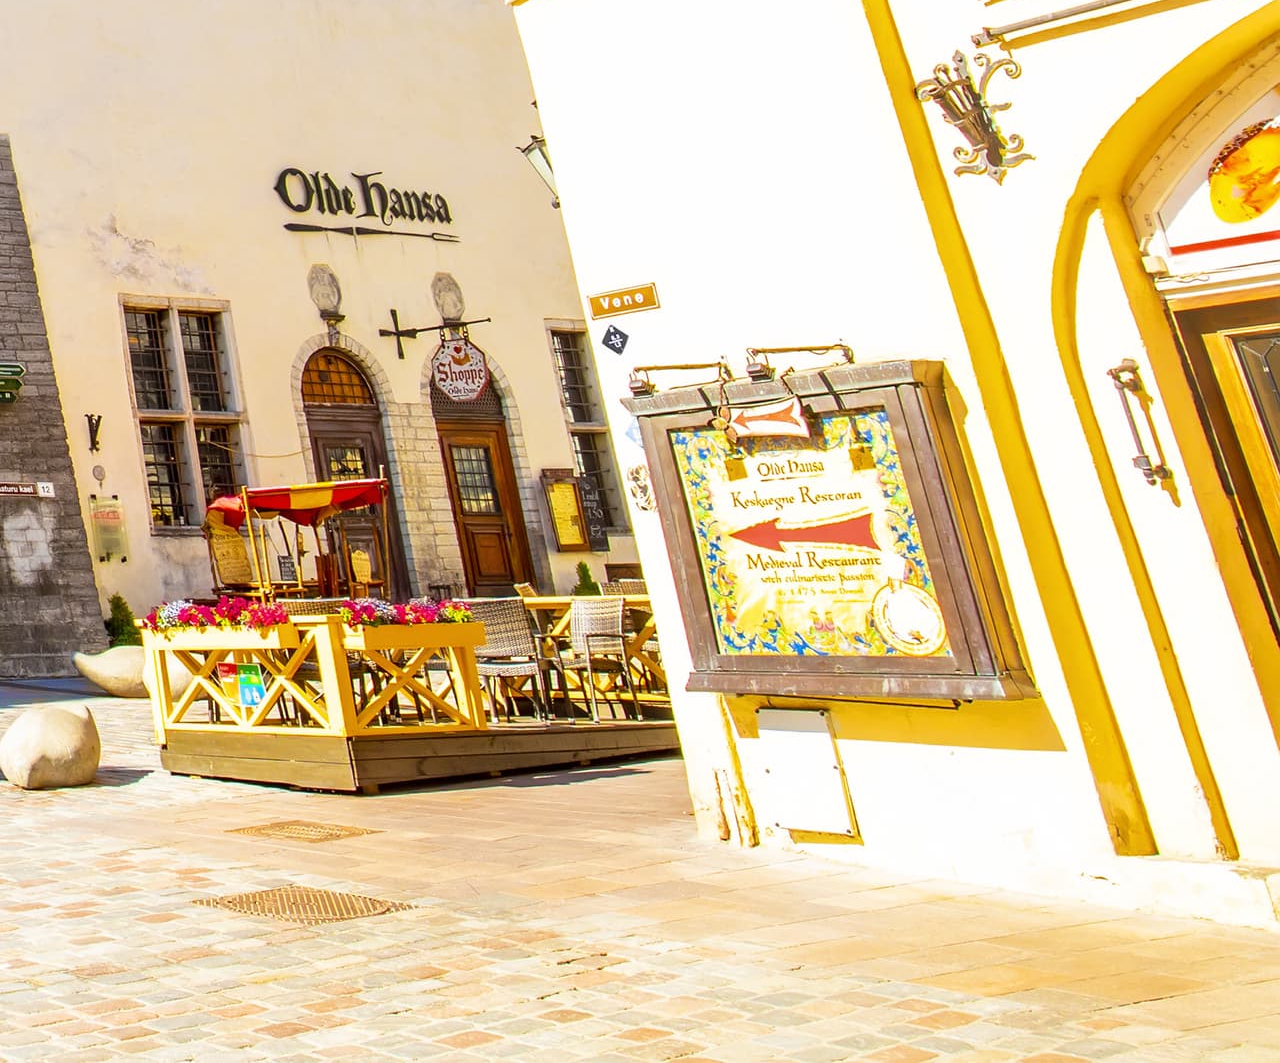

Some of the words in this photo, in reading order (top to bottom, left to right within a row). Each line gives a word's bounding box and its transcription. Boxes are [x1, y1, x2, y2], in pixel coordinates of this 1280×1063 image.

[273, 167, 355, 216] Olde
[351, 171, 453, 226] Hansa
[436, 359, 484, 386] Shoppe
[757, 461, 786, 477] Olde
[787, 459, 825, 474] Hansa
[19, 485, 34, 493] kael
[41, 485, 50, 494] 12
[730, 489, 795, 511] Keskaegne
[798, 485, 862, 505] Restoran
[746, 552, 803, 572] Medieval
[807, 551, 882, 569] Restaurant
[760, 570, 782, 584] with
[839, 572, 875, 586] passion
